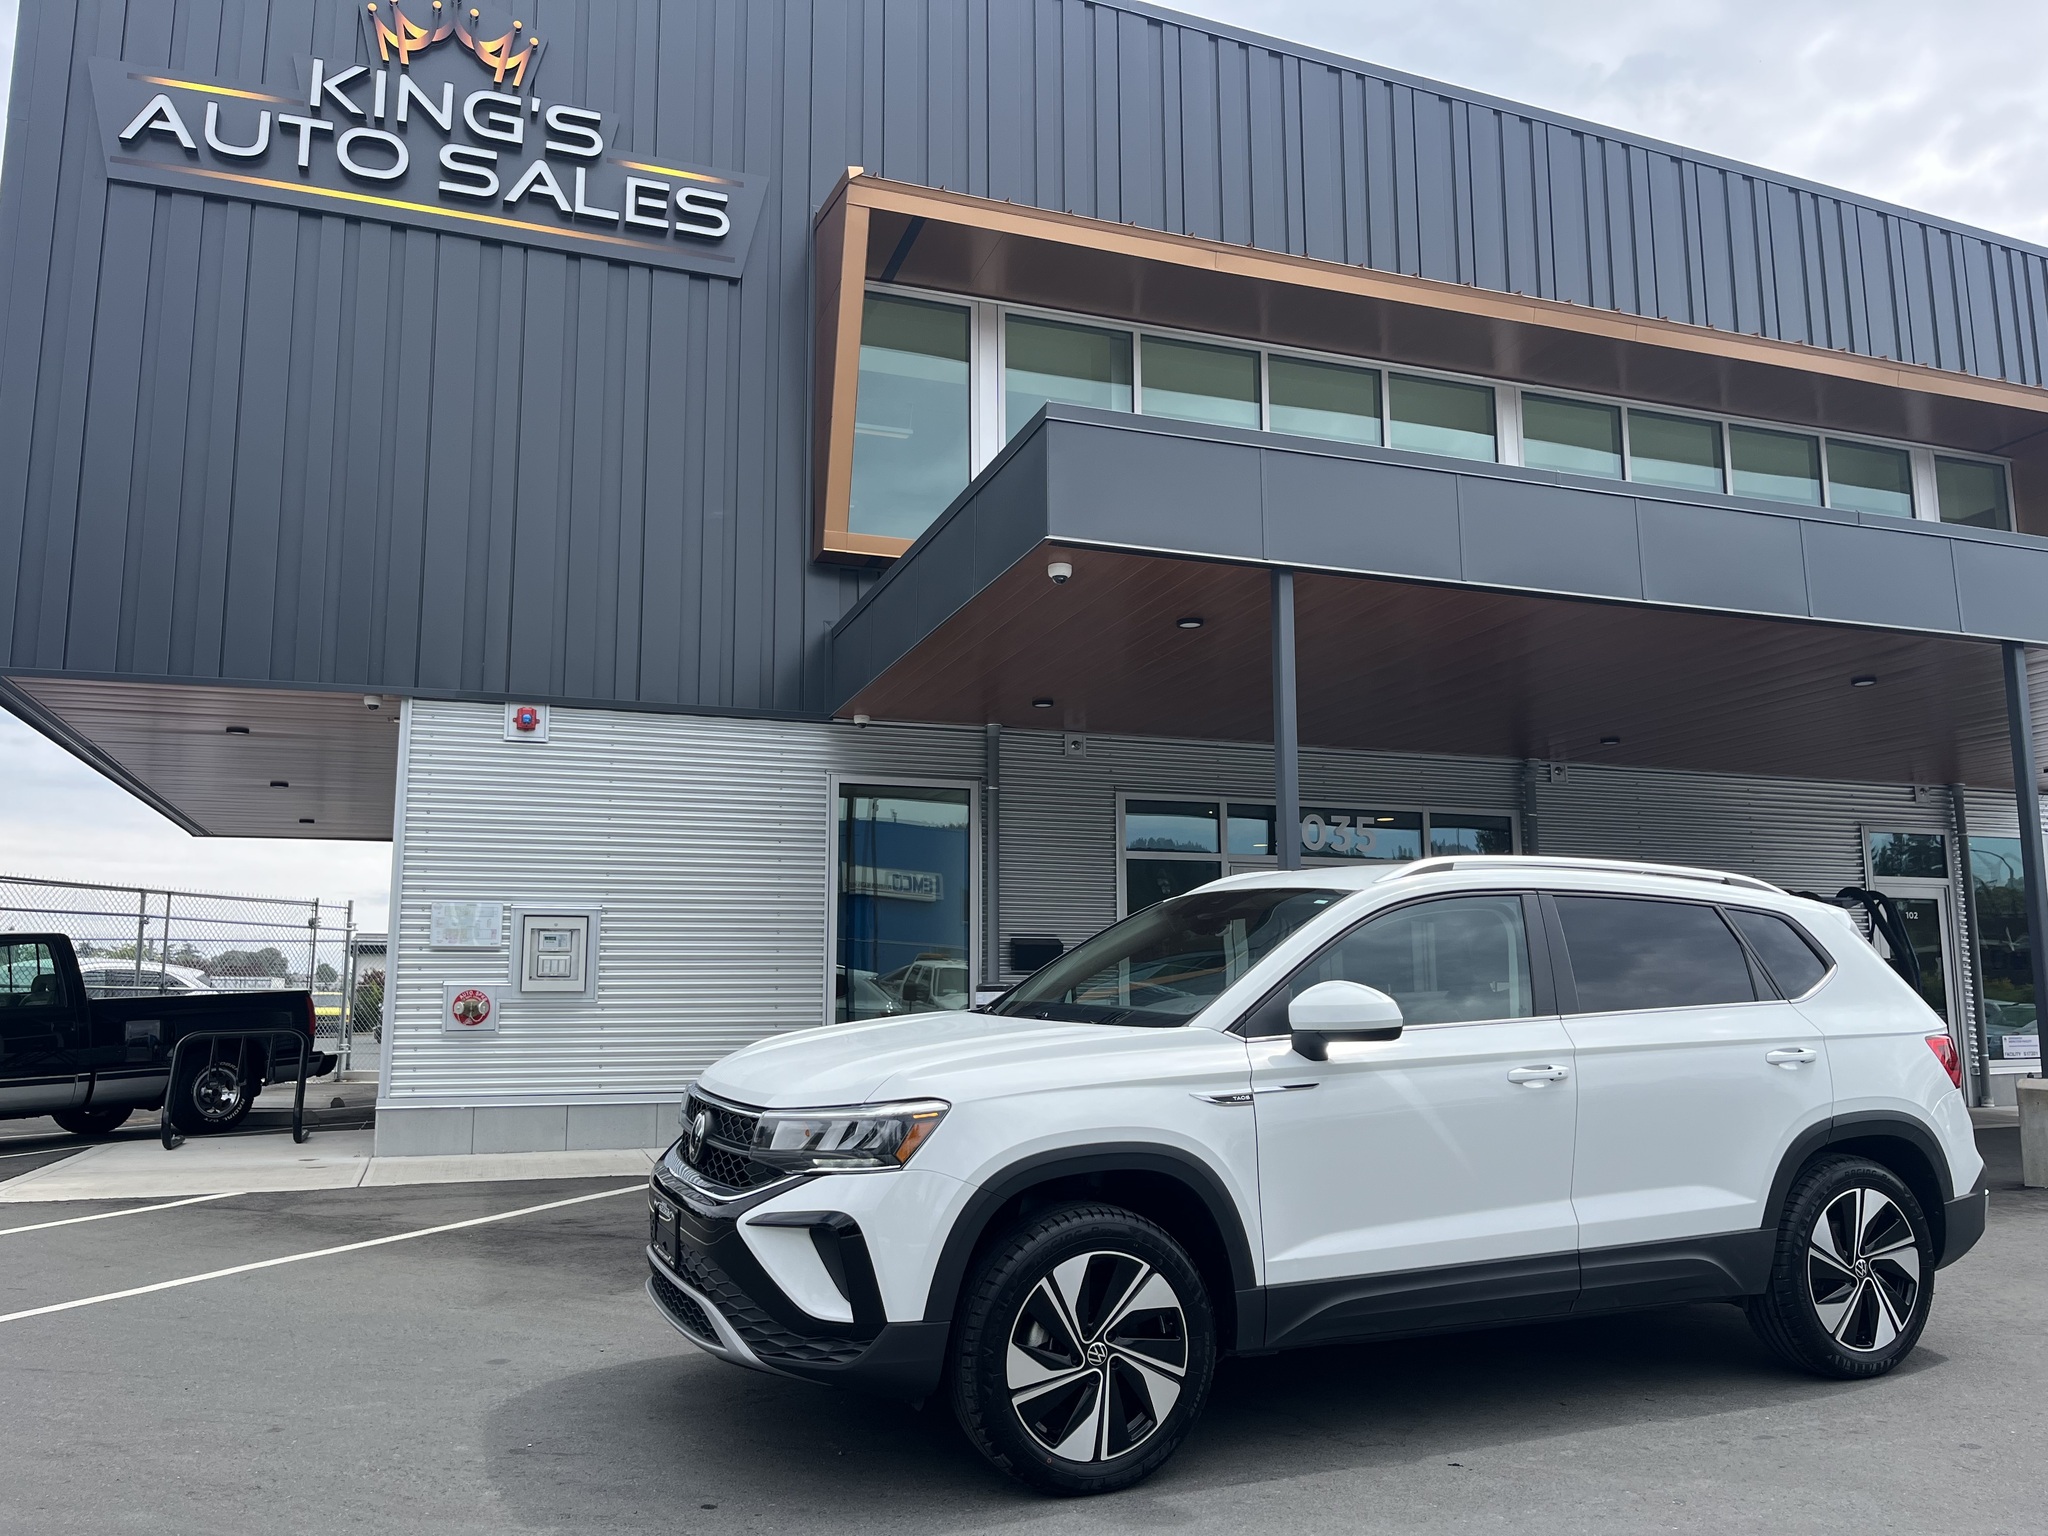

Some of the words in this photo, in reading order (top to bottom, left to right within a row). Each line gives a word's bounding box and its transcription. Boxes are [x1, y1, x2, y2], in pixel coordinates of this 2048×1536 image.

[310, 57, 605, 158] KING'S
[118, 93, 410, 181] AUTO
[437, 142, 731, 239] SALES
[1300, 813, 1377, 852] 035
[1905, 911, 1919, 920] 102
[459, 990, 474, 1001] AUTO
